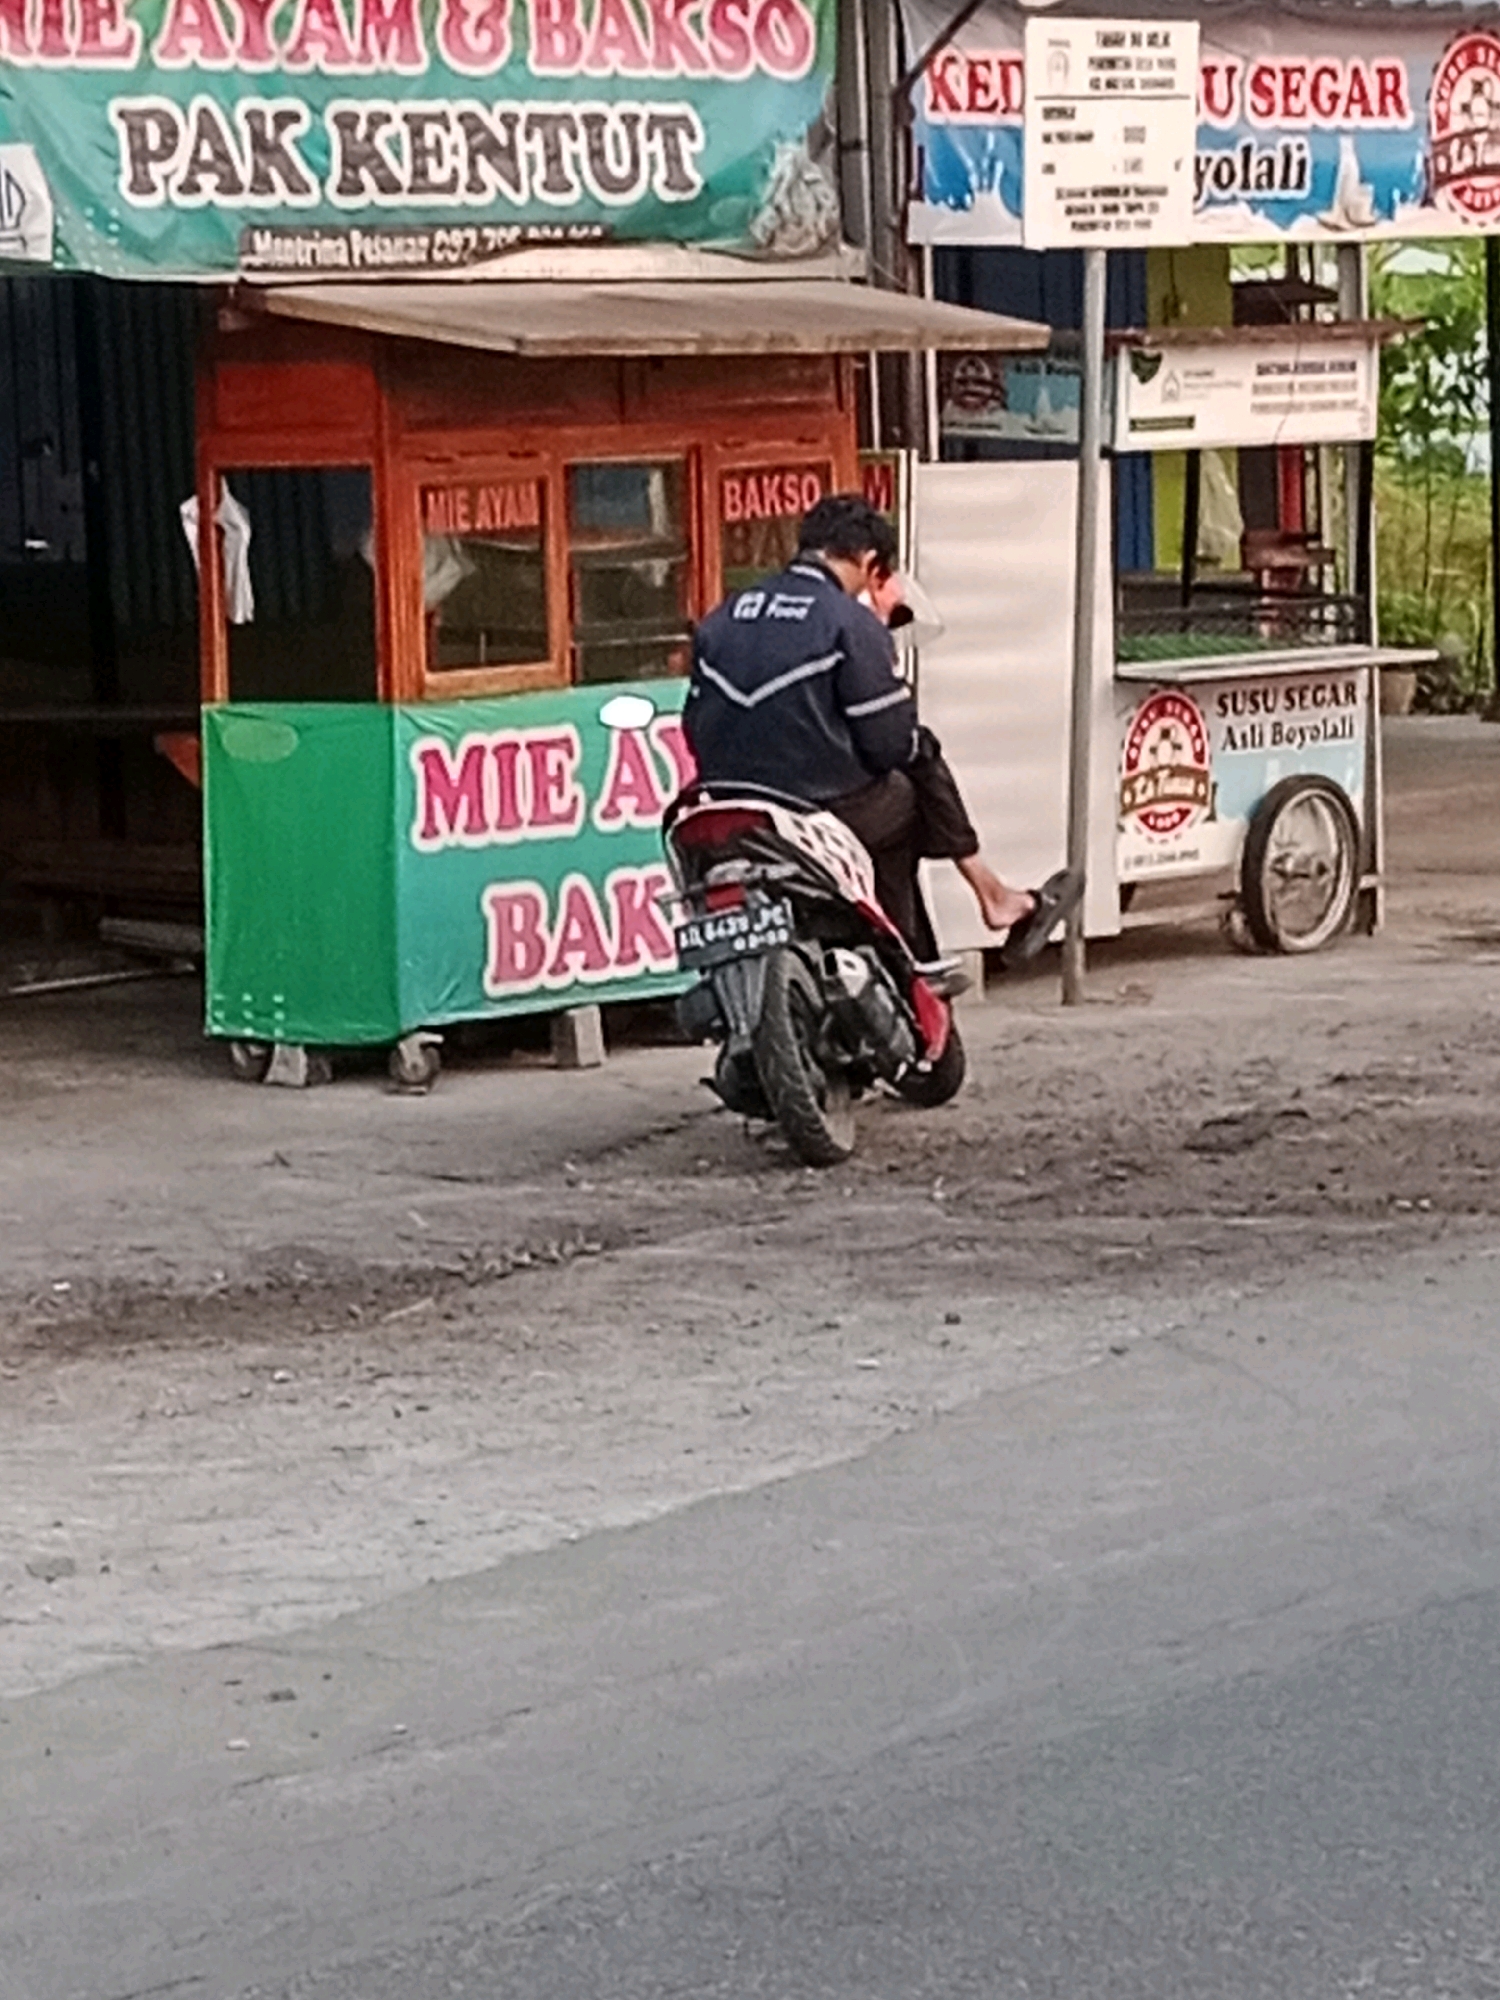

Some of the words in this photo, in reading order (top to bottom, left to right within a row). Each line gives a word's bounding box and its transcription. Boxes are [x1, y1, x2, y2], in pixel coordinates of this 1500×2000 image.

[158, 0, 425, 66] AYAM
[443, 0, 502, 67] &
[532, 0, 813, 74] BAKSO
[1251, 65, 1408, 118] SEGAR
[117, 105, 314, 196] PAK
[331, 109, 698, 197] KENTUT
[1194, 142, 1306, 203] yolali
[427, 488, 472, 532] MIE
[474, 481, 539, 531] AYAM
[723, 473, 821, 521] BAKSO
[1215, 687, 1278, 718] SUSU
[1283, 681, 1358, 711] SEGAR
[1270, 715, 1354, 751] Boyolali
[418, 737, 580, 840] MIE
[490, 875, 675, 985] BAK
